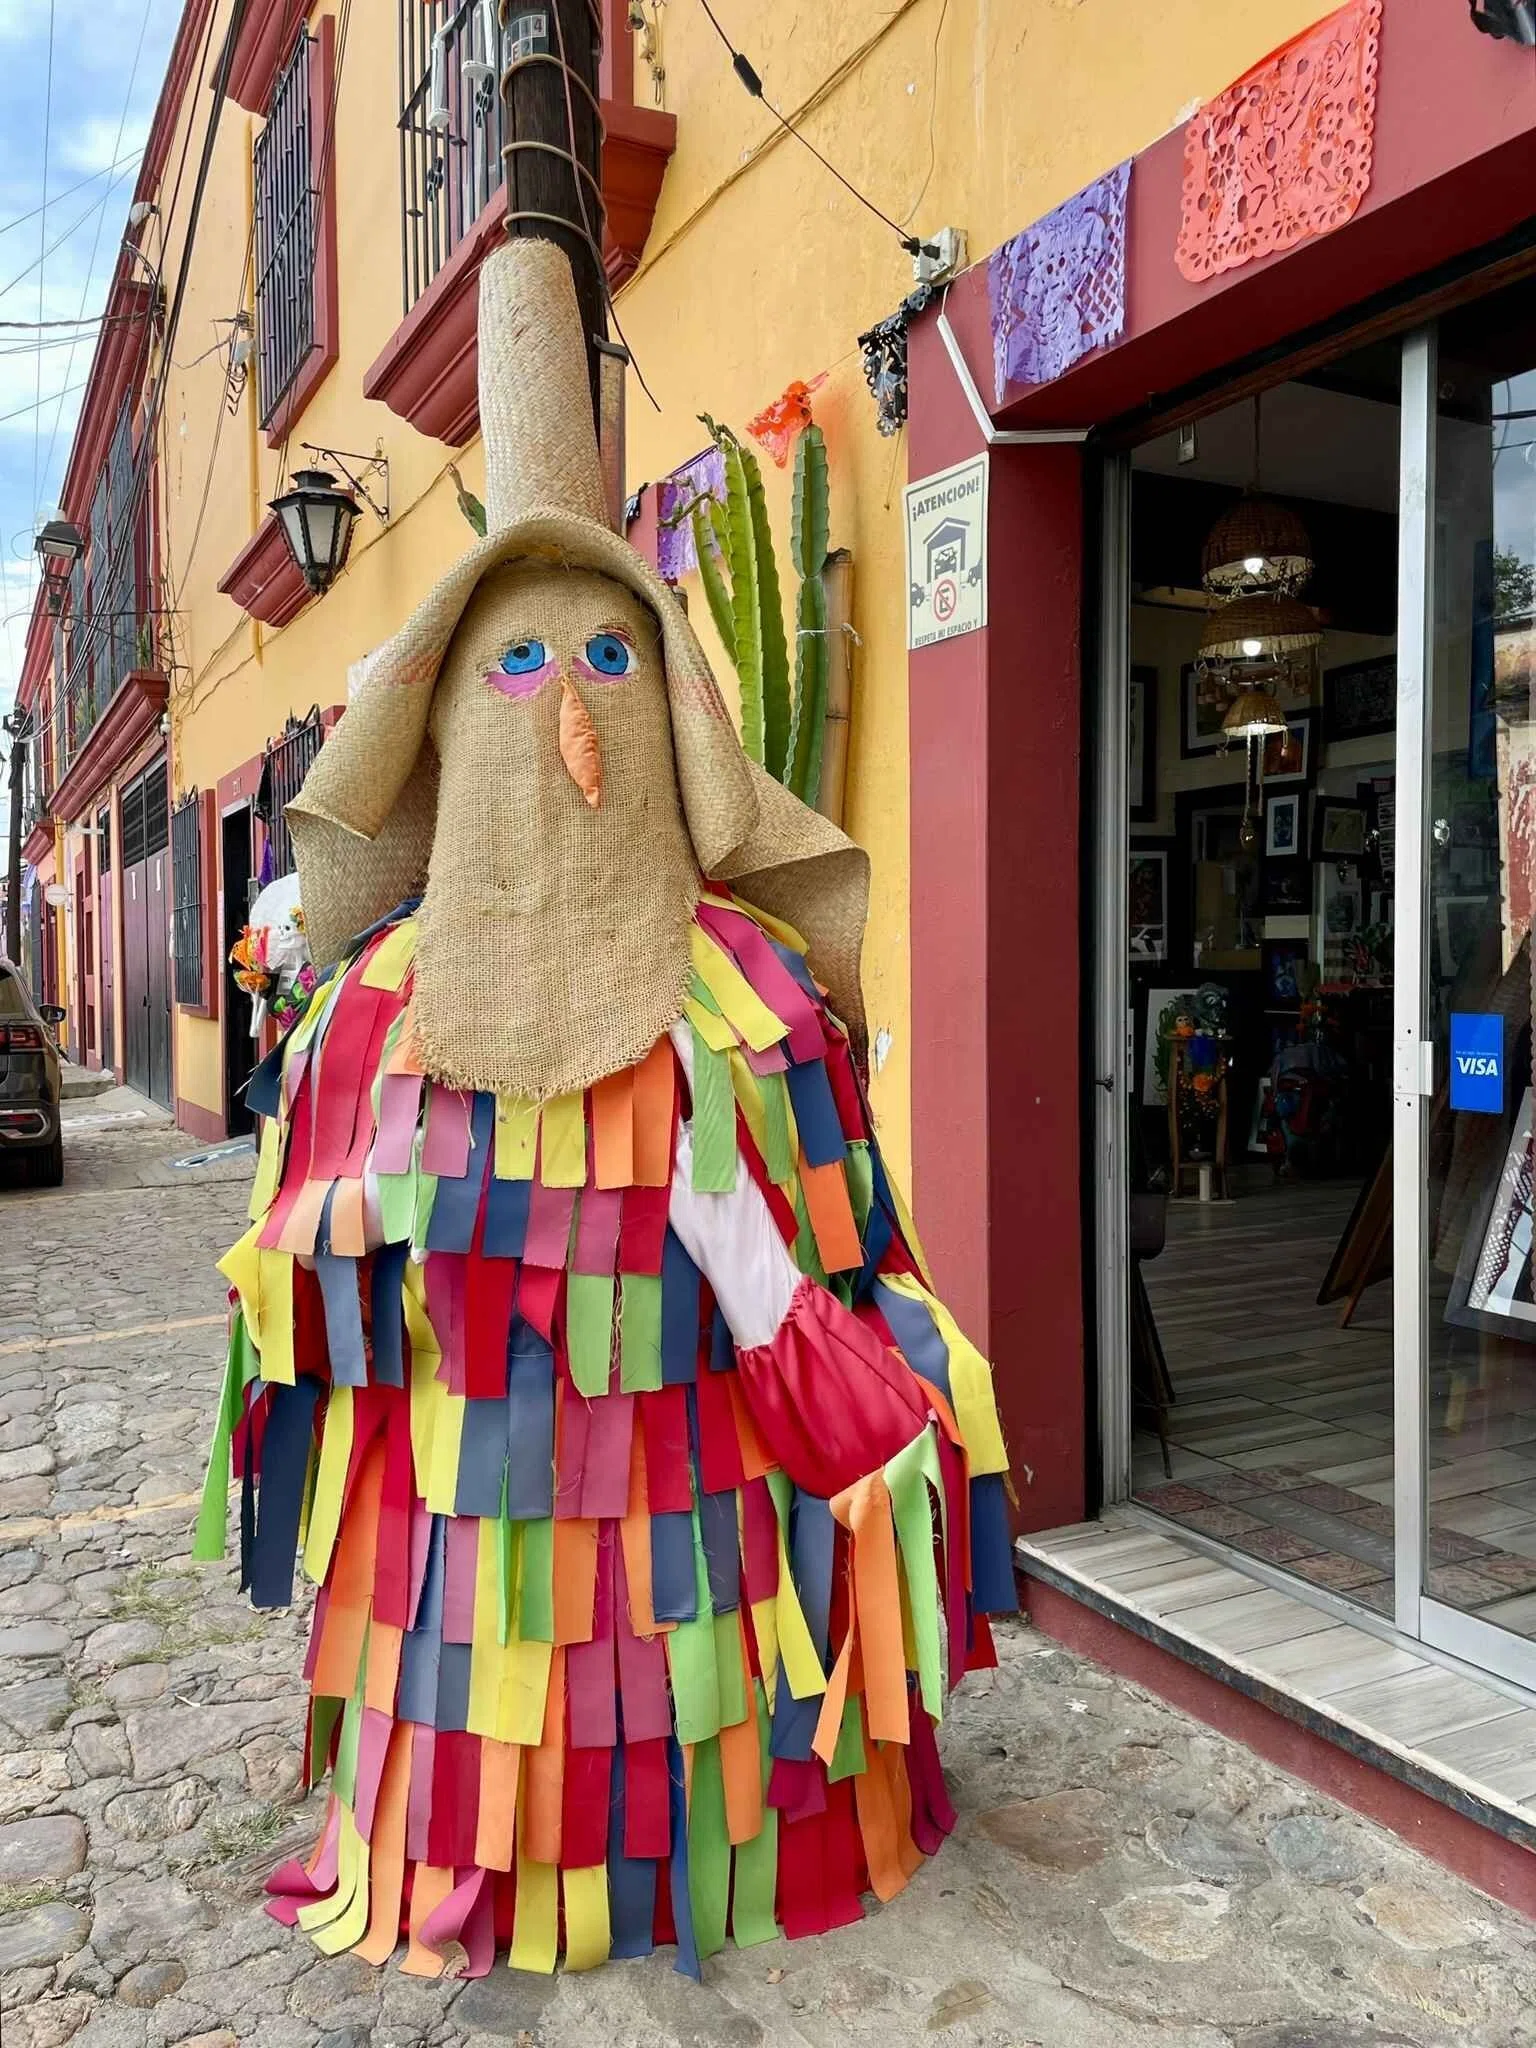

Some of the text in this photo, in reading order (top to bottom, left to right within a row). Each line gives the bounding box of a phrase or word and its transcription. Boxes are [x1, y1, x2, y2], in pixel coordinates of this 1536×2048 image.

[912, 476, 979, 521] ¡ATENCION!
[947, 620, 972, 636] ESPACIO
[1456, 1056, 1498, 1076] VISA
